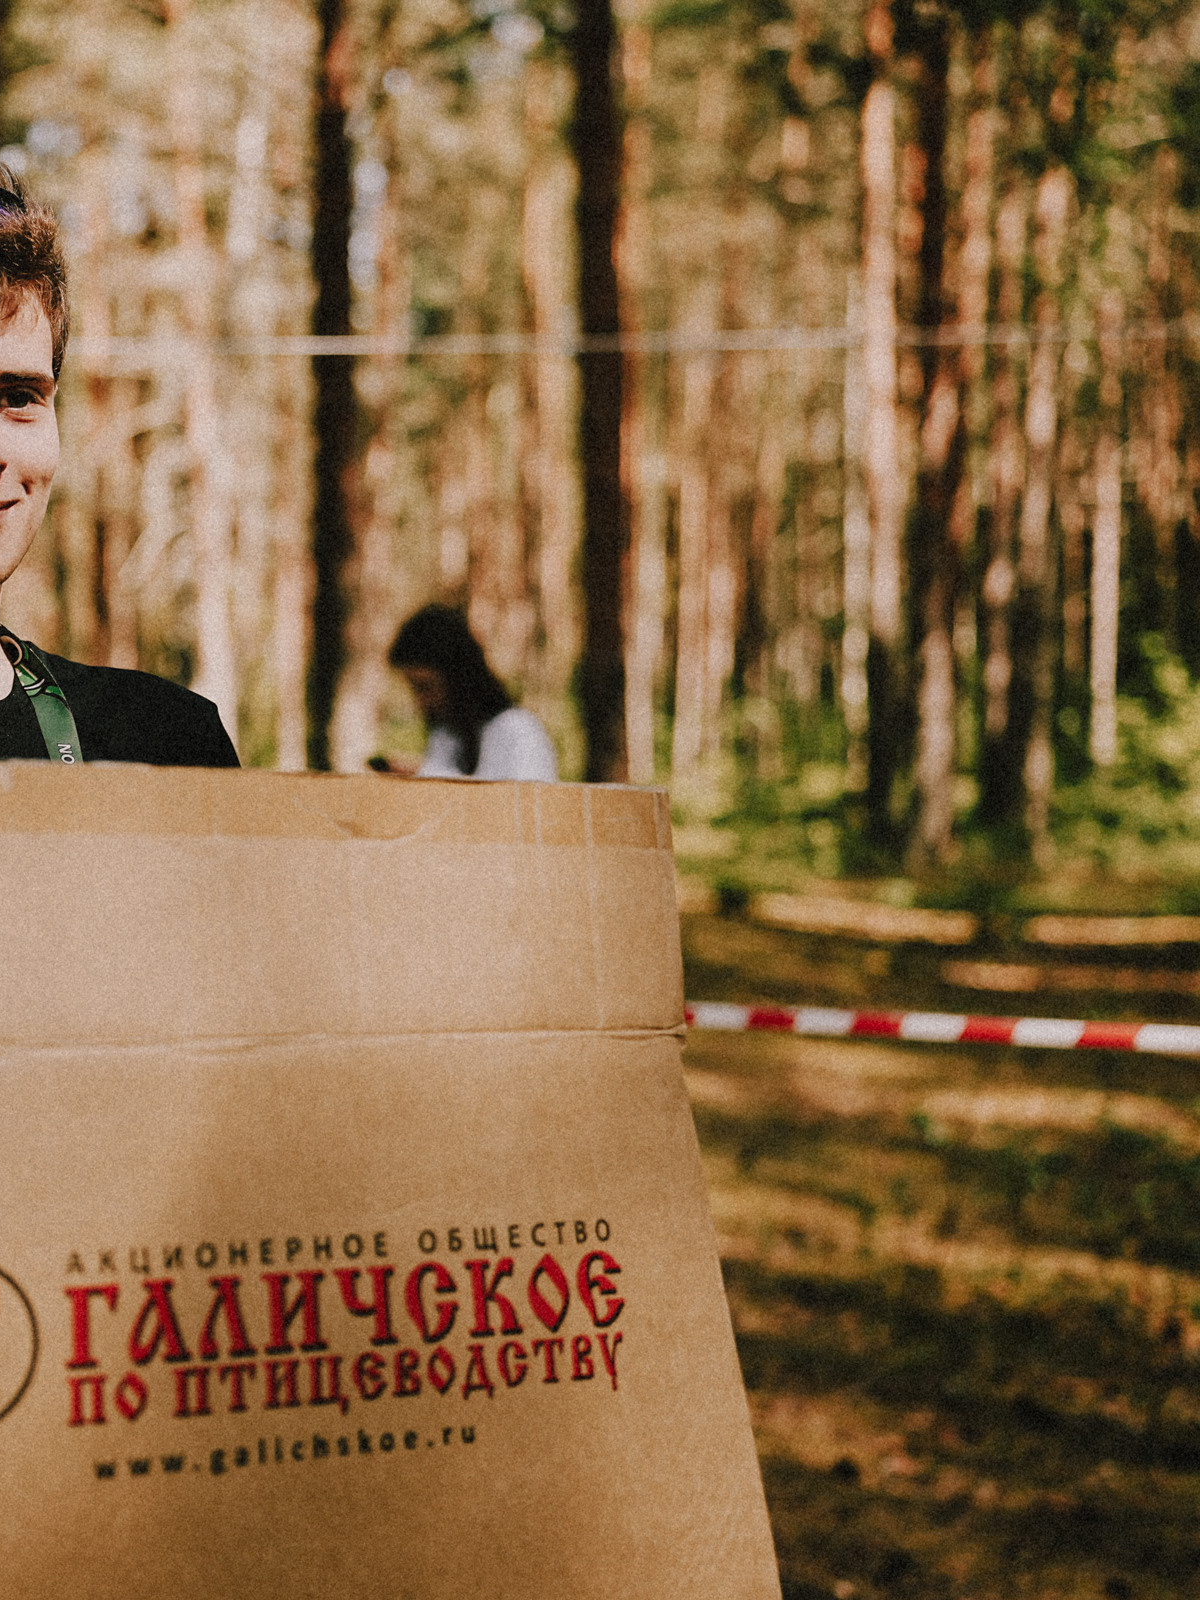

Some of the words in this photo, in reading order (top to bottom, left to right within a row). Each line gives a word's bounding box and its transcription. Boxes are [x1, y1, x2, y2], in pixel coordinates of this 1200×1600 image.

[65, 1232, 388, 1275] АКЦИОНЕРНОЕ
[417, 1218, 611, 1254] ОБЩЕСТВО
[64, 1250, 625, 1370] ГАЛИЧСКОЕ
[67, 1371, 149, 1426] ПО
[173, 1331, 624, 1418] ПТИЦЕВОДСТВУ
[95, 1425, 476, 1479] www.galichskoe.ru
